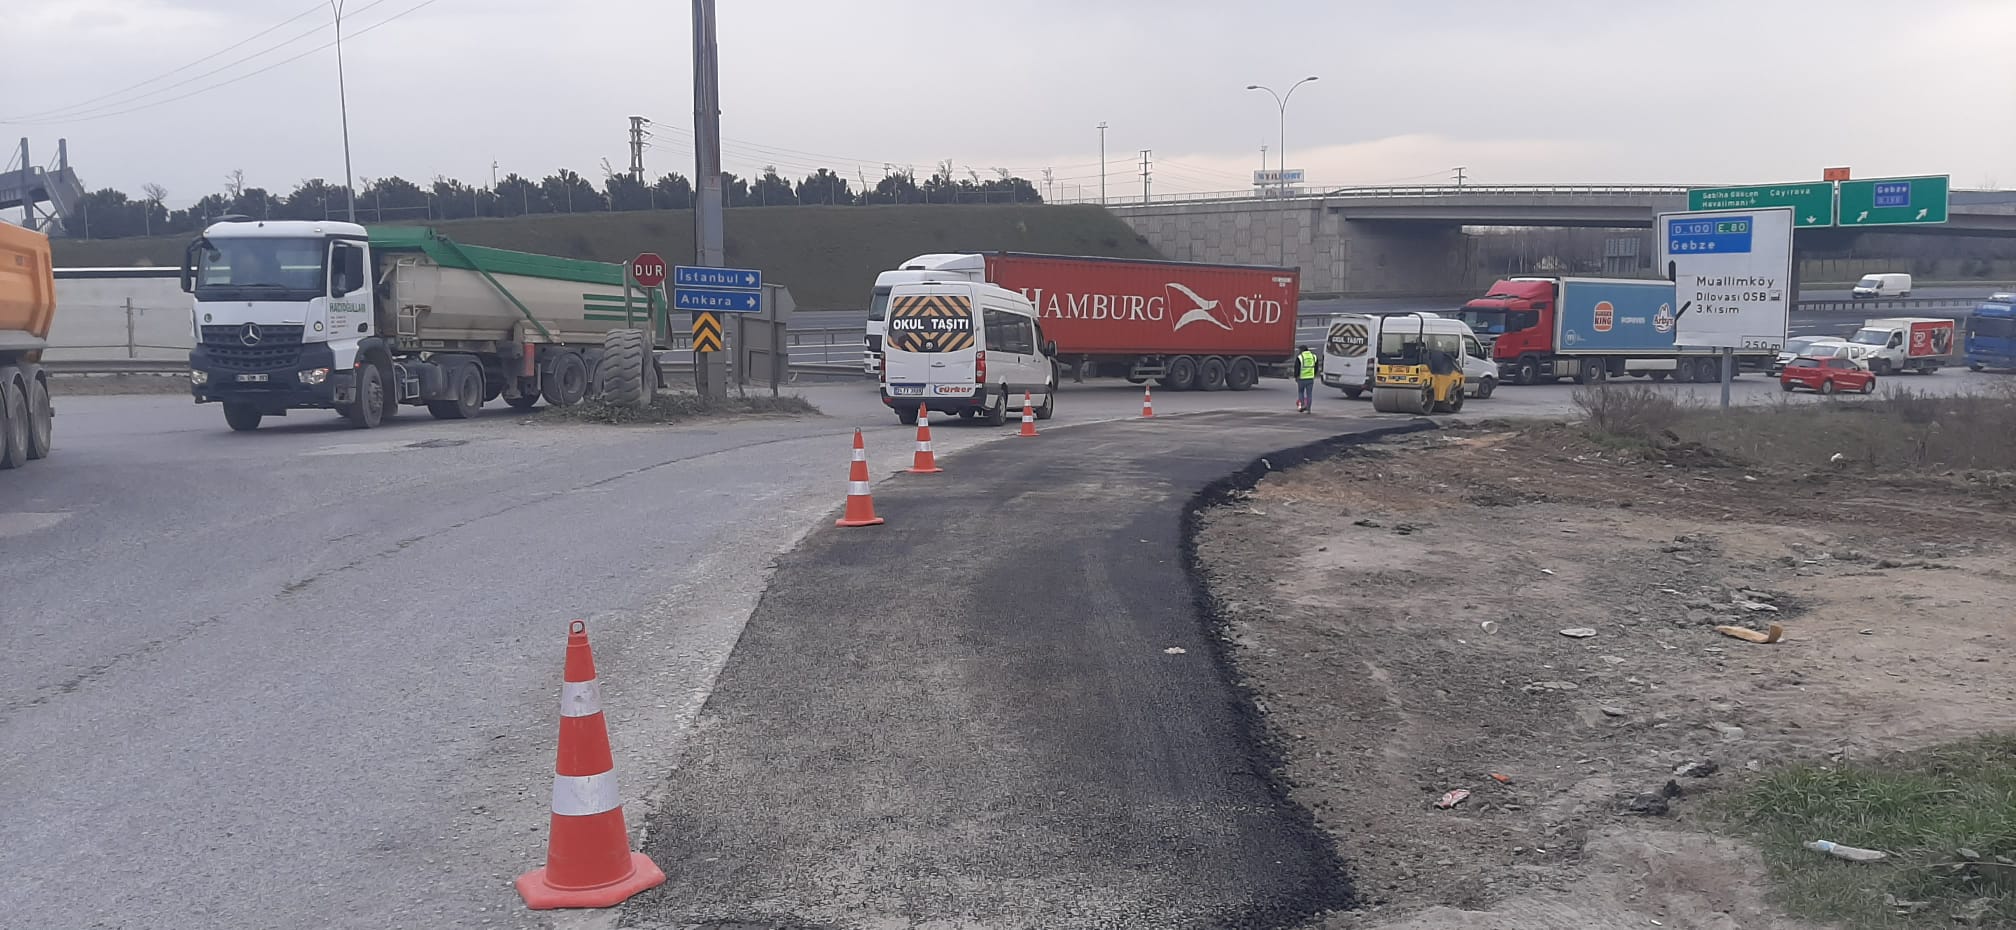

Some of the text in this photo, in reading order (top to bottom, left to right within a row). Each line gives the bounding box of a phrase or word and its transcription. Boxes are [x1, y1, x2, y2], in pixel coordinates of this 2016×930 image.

[1671, 240, 1716, 251] Gebze
[635, 264, 663, 277] DUR
[680, 293, 732, 307] Ankara
[1742, 291, 1767, 302] OSB
[1020, 287, 1282, 324] HAMBURG SÜD
[893, 318, 970, 333] OKUL TAŞITI
[1594, 316, 1612, 325] KING
[1744, 340, 1781, 351] 250 m
